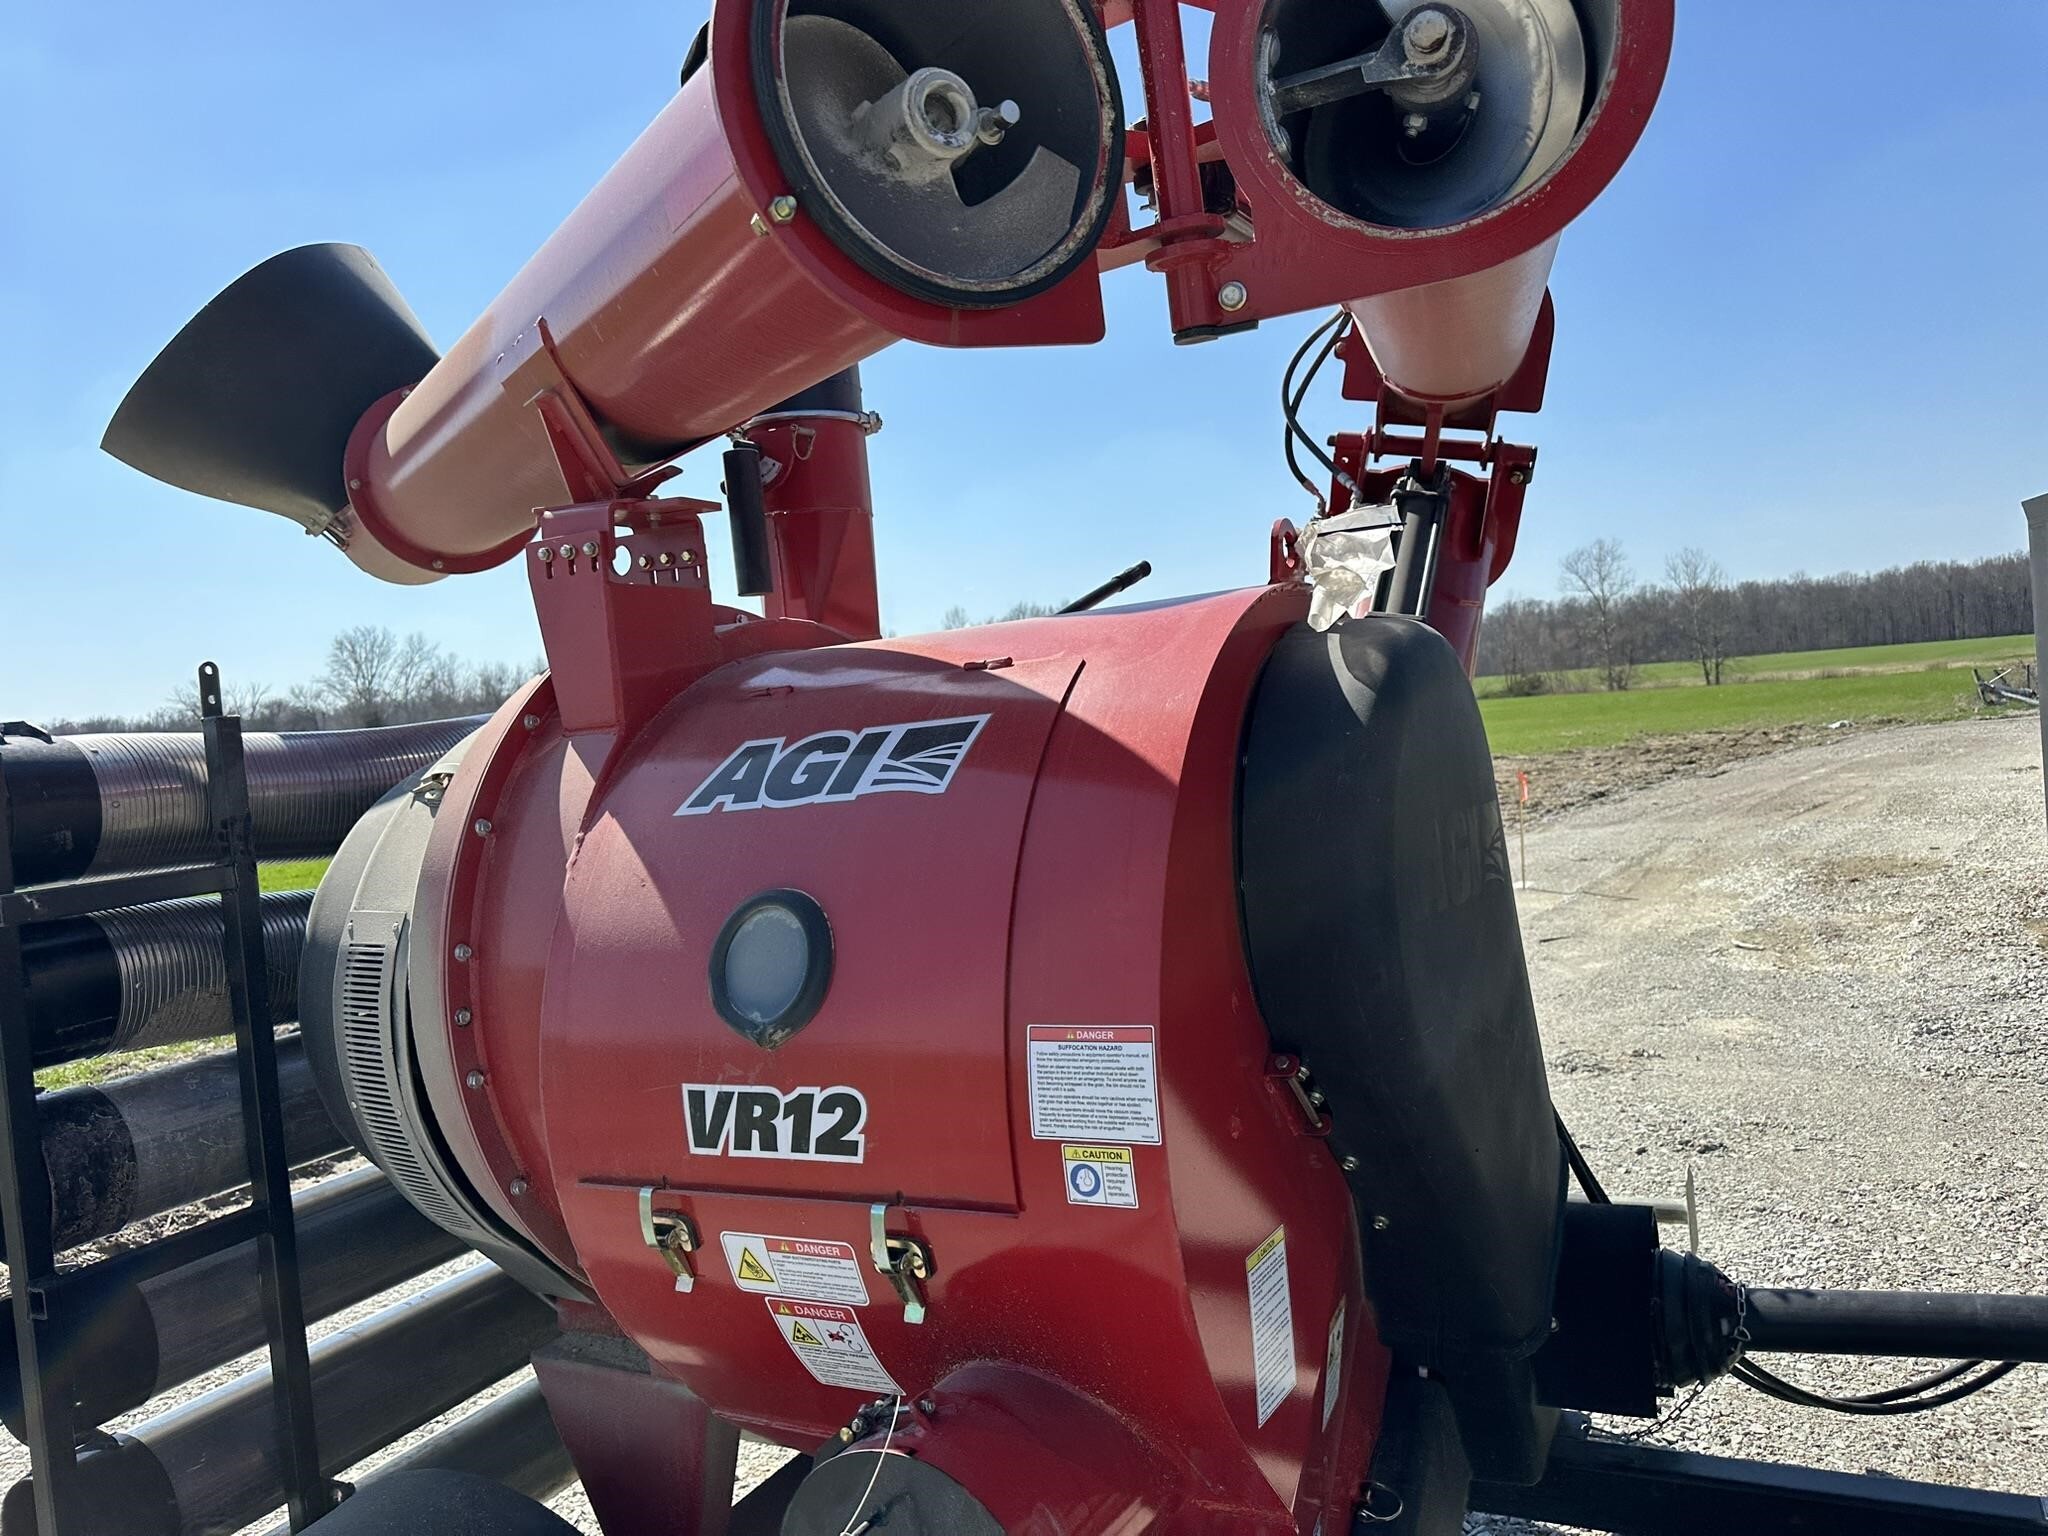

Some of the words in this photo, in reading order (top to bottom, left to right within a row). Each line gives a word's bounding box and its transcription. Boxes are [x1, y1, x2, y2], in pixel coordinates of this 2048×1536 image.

[681, 730, 885, 812] AGI
[1076, 1030, 1114, 1041] DANGER
[687, 1087, 864, 1160] VR12
[1082, 1150, 1123, 1160] CAUTION
[795, 1242, 840, 1257] DANGER
[794, 1305, 846, 1320] DANGER
